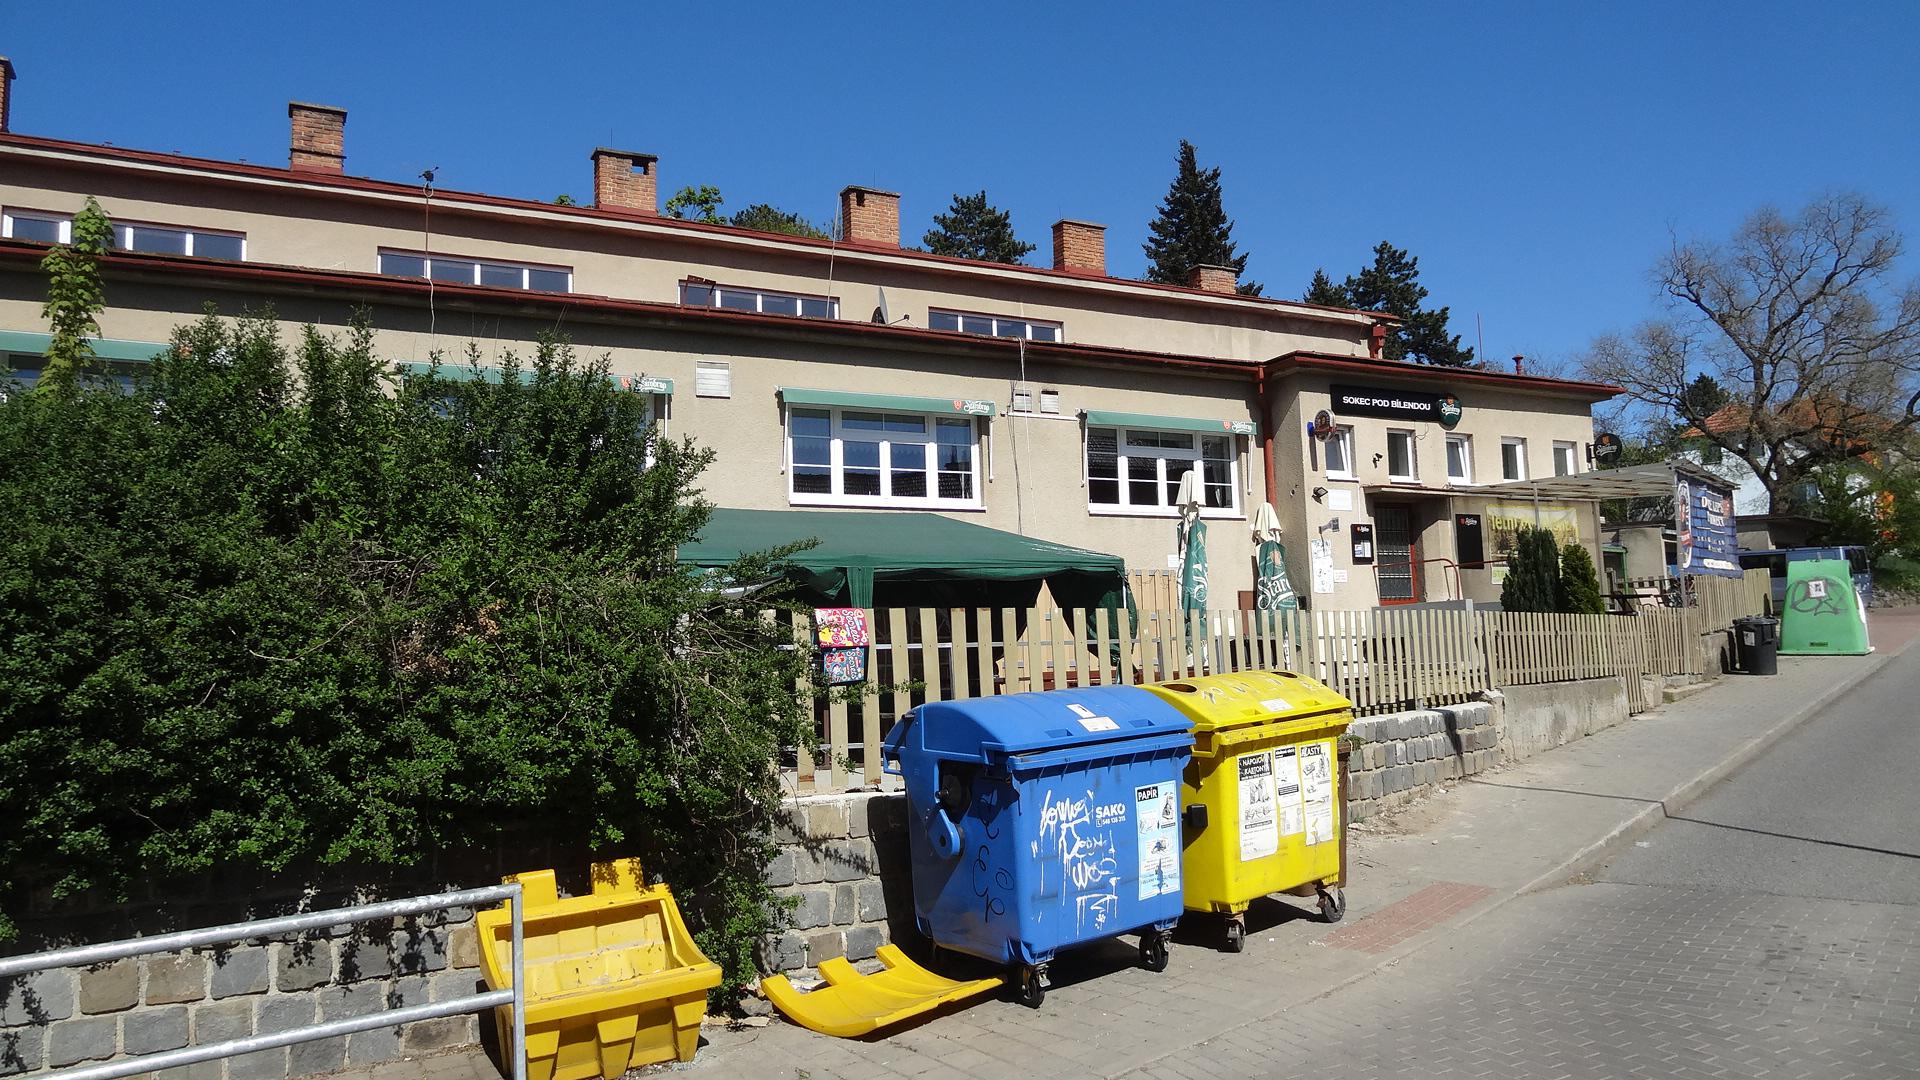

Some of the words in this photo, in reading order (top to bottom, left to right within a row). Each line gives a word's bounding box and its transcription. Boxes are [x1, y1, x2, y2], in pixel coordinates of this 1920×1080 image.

[1342, 396, 1371, 406] SOKEC
[1372, 399, 1390, 407] POD
[1138, 787, 1158, 801] PAPÍR
[1095, 803, 1126, 818] SAKO
